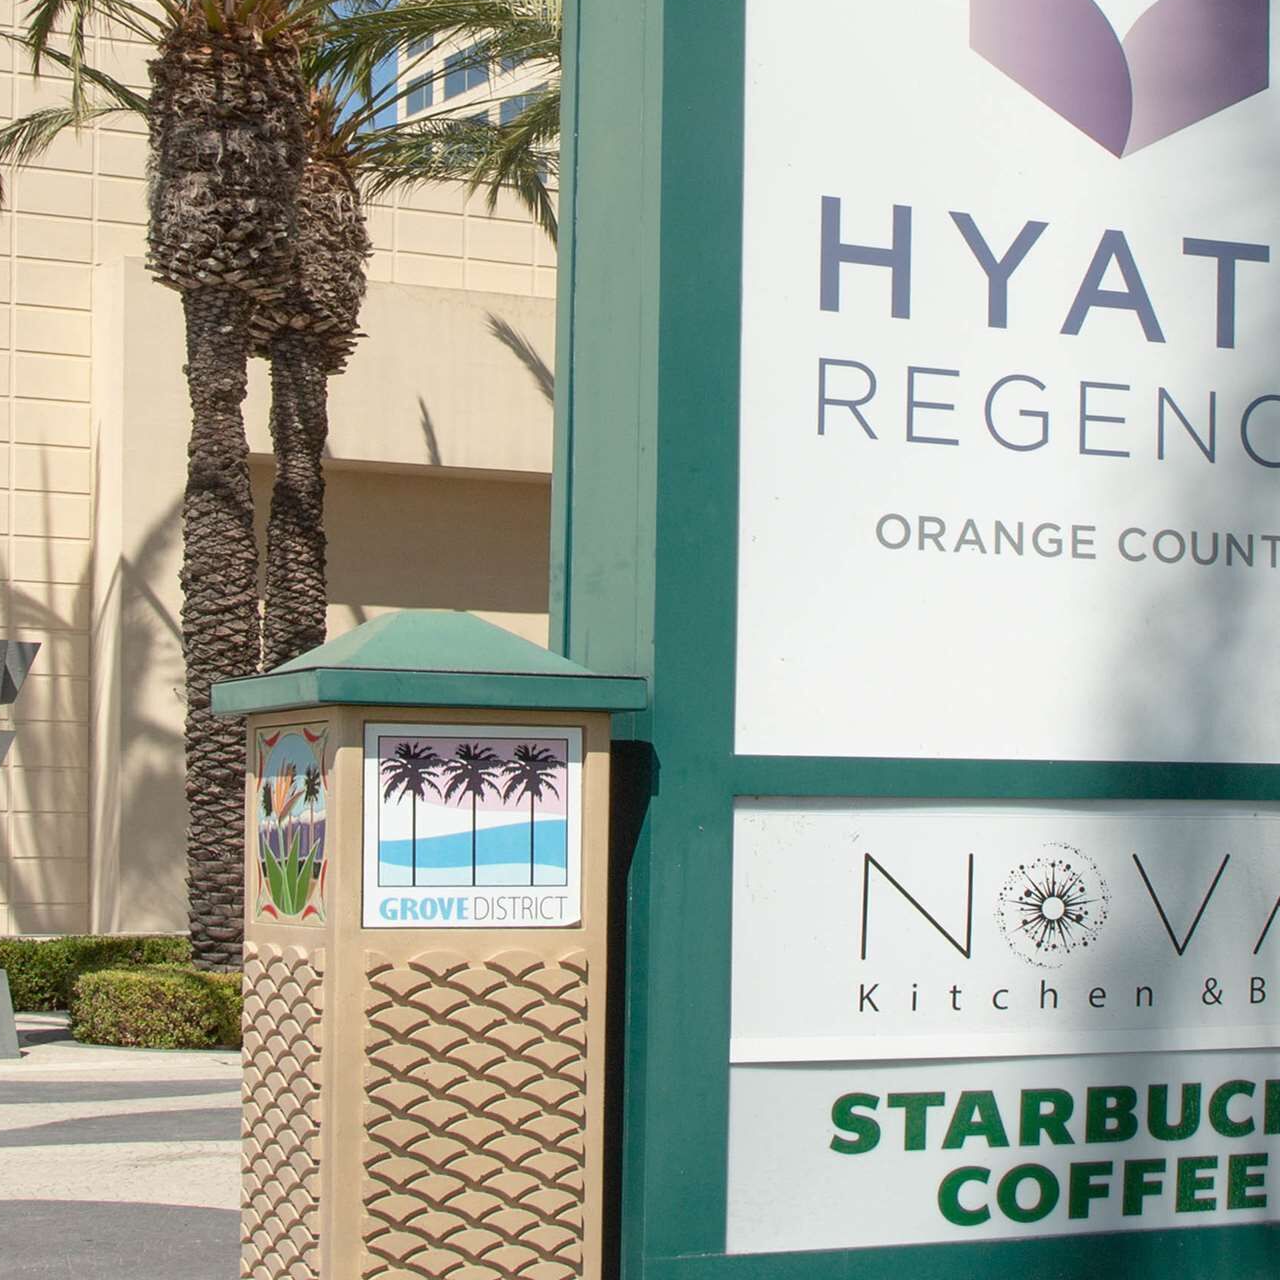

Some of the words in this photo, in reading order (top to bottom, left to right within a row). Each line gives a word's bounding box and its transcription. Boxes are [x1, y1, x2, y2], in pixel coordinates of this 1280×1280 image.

[875, 513, 1097, 560] ORANGE
[379, 896, 469, 921] GROVE
[474, 896, 569, 921] DISTRICT
[859, 980, 1153, 1012] Kitchen
[937, 1152, 1269, 1227] COFFEE
